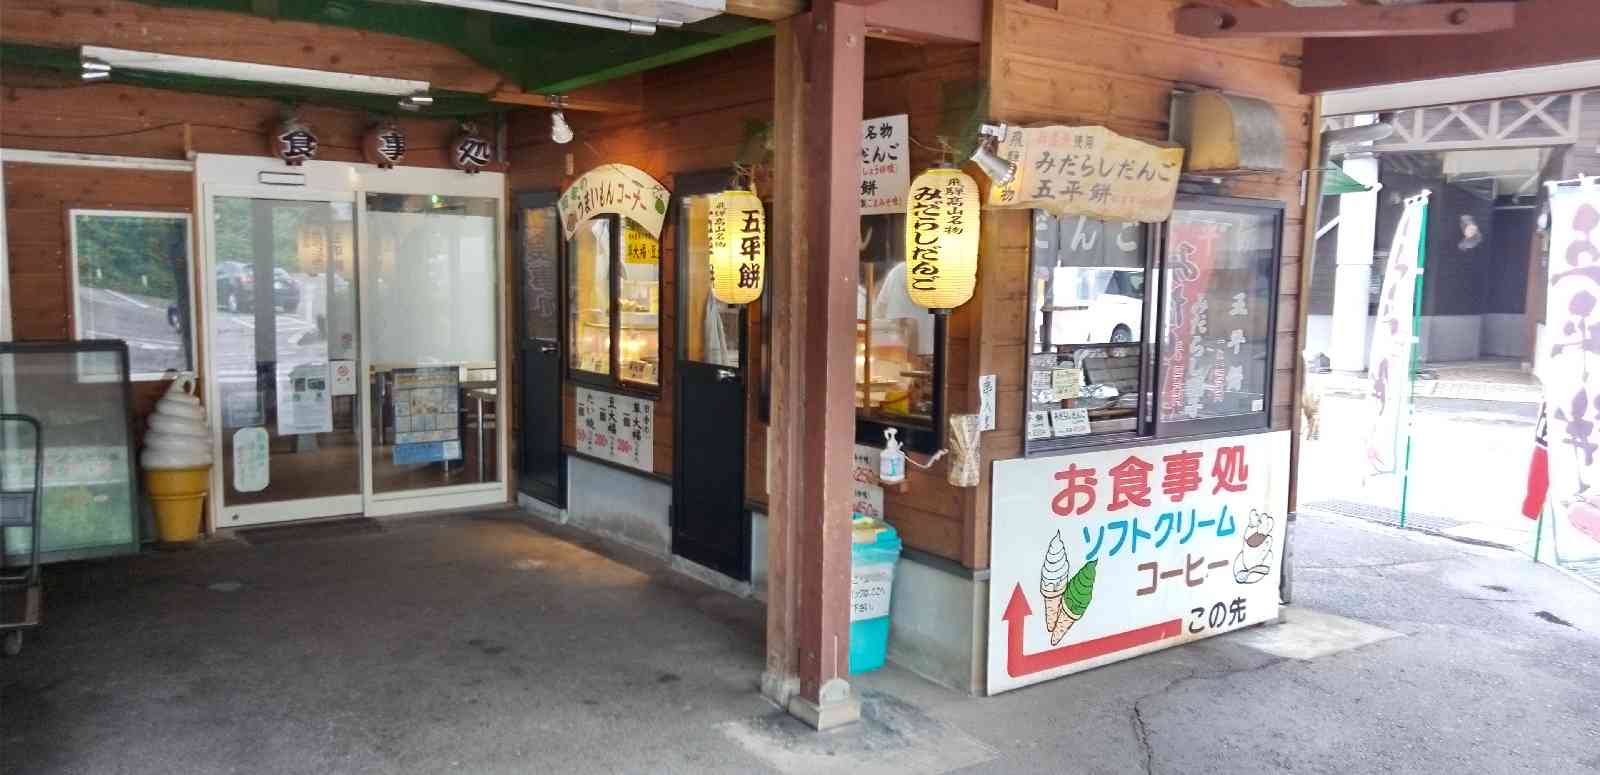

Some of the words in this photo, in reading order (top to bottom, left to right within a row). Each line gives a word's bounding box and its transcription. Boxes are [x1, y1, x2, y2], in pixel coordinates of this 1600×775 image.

[279, 130, 318, 159] 食
[378, 133, 406, 161] 事
[864, 122, 893, 140] 名物
[456, 138, 491, 166] 処
[1035, 151, 1177, 182] みだらしだんご
[860, 179, 878, 196] 餅
[1032, 179, 1113, 204] 五平餅
[944, 177, 965, 236] 飛騨高山名物
[738, 209, 761, 289] 五平餅
[911, 186, 943, 291] みだらしだんご
[1051, 445, 1249, 516] お食事処
[1083, 504, 1236, 561] ソフトクリーム
[1136, 553, 1230, 597] コーヒー
[1187, 597, 1247, 634] この先
